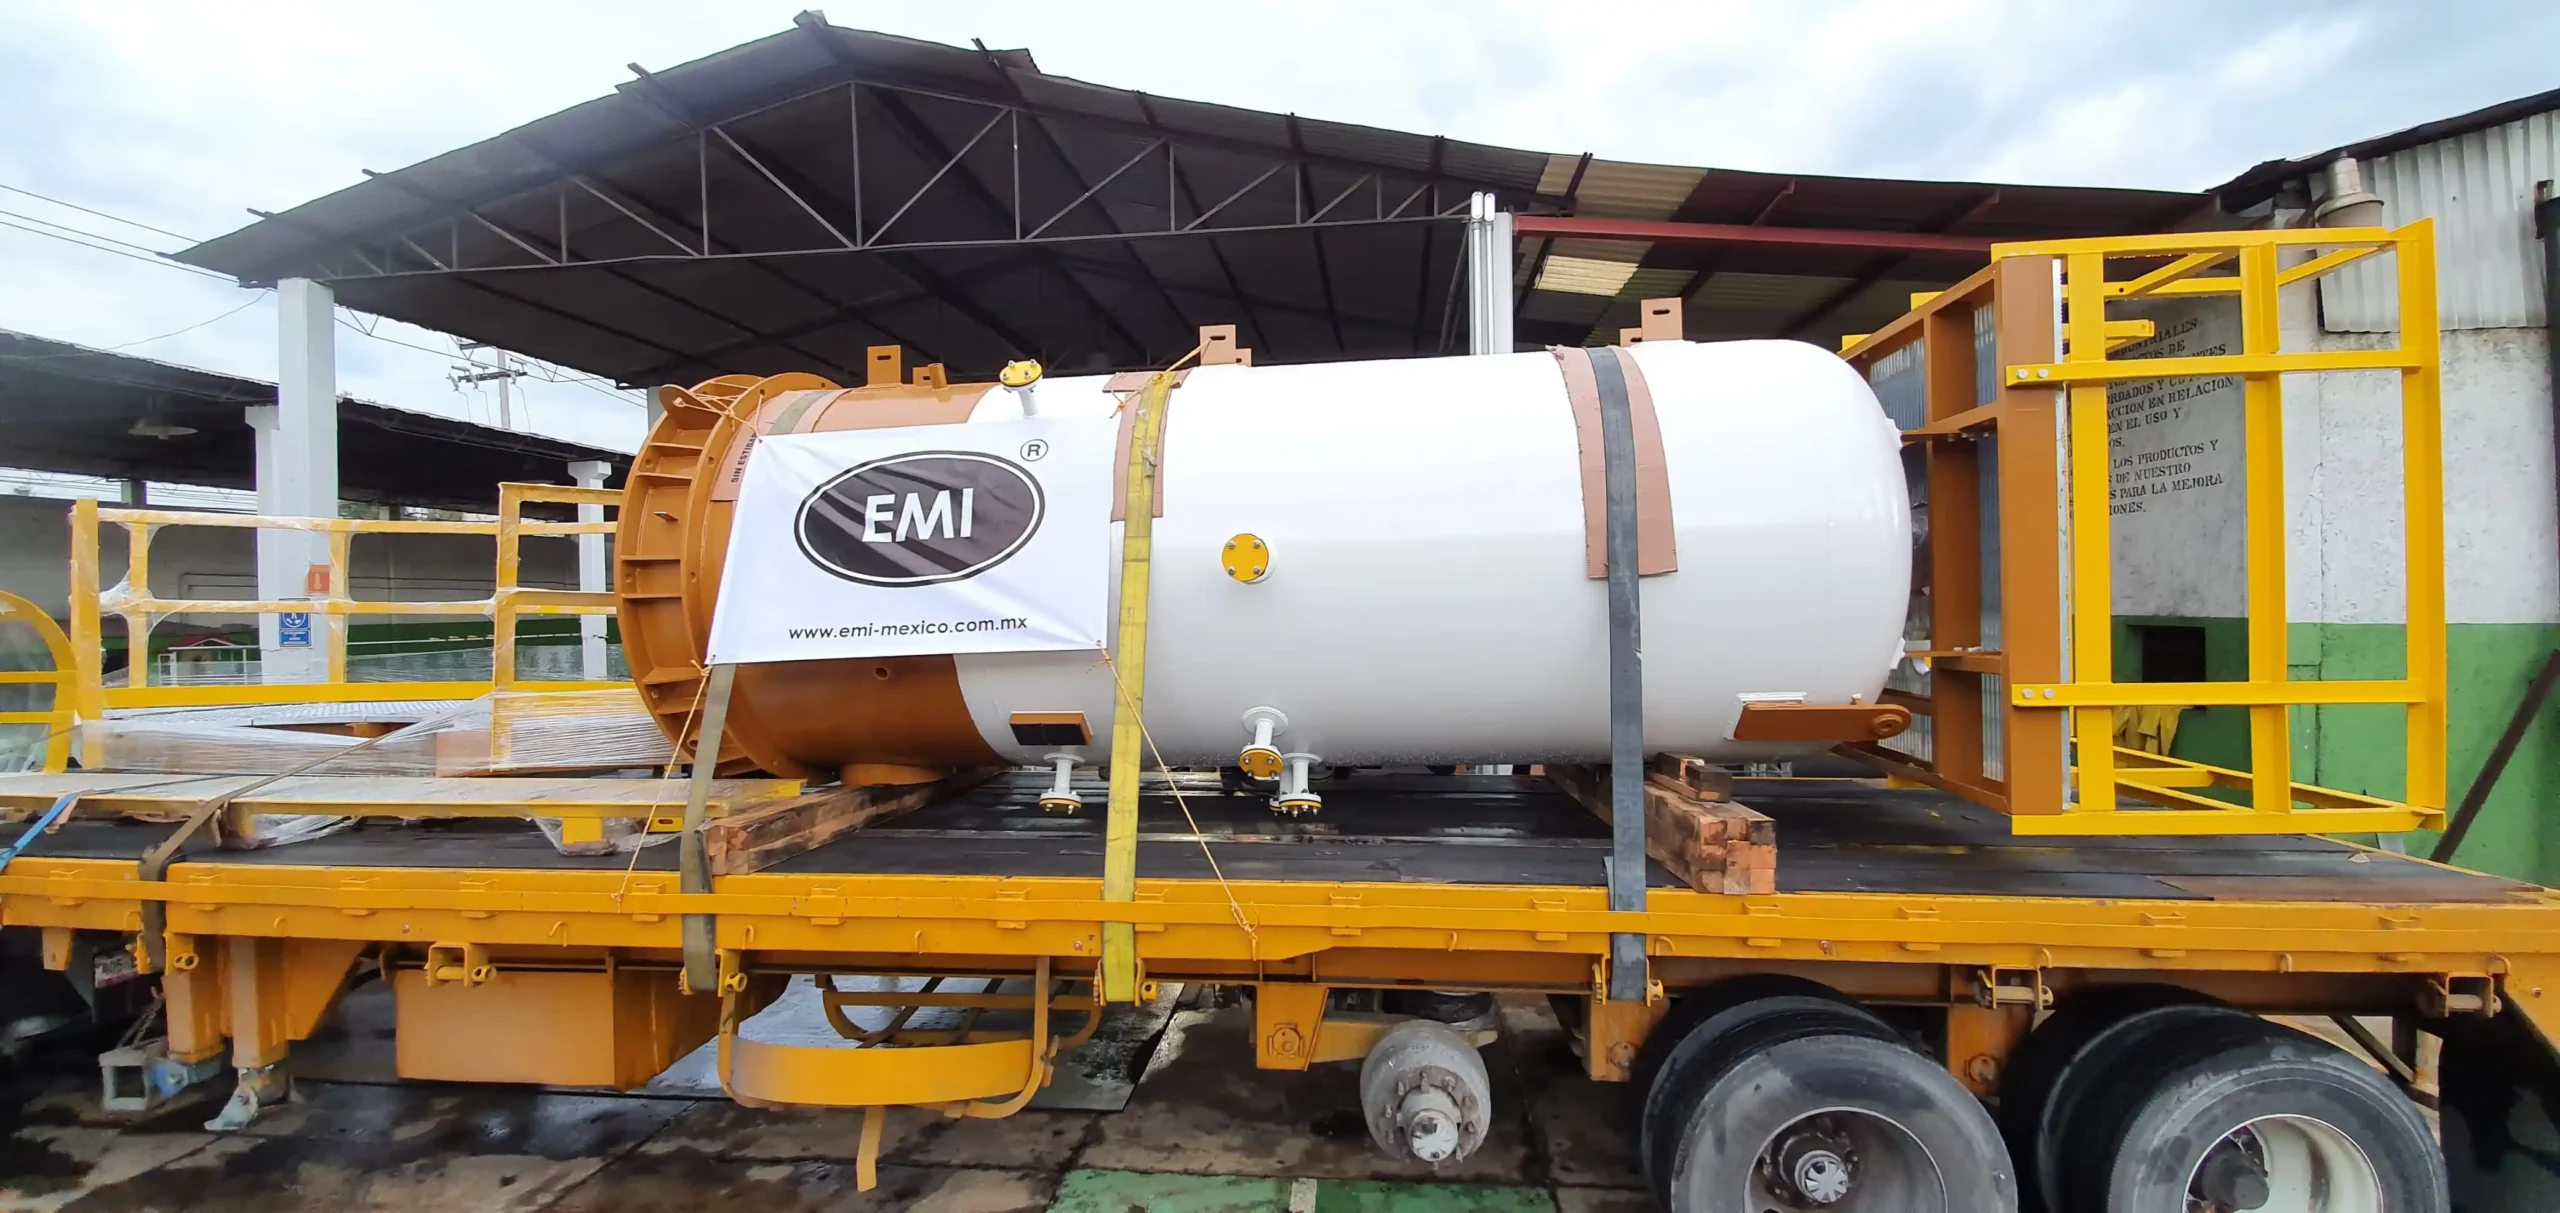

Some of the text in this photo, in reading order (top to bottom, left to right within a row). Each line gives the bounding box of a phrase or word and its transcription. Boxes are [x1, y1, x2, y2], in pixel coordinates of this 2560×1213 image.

[2168, 340, 2186, 355] DE
[2148, 394, 2165, 410] EN
[2168, 375, 2234, 403] RELACION
[2157, 379, 2165, 390] Y
[2126, 417, 2141, 430] EL
[2145, 410, 2168, 425] USO
[2173, 407, 2183, 419] Y
[2109, 437, 2126, 449] OS.
[2113, 439, 2219, 469] LOS PRODUCTOS Y
[731, 467, 743, 483] SIN
[2116, 471, 2130, 484] DE
[2134, 462, 2191, 481] NUESTRO
[2120, 485, 2147, 499] PARA
[2151, 481, 2168, 495] LA
[2172, 472, 2223, 492] MEJORA
[862, 488, 974, 543] EMI
[2109, 502, 2146, 516] IONES.
[788, 617, 1028, 640] www.emi-mexico.com.mx
